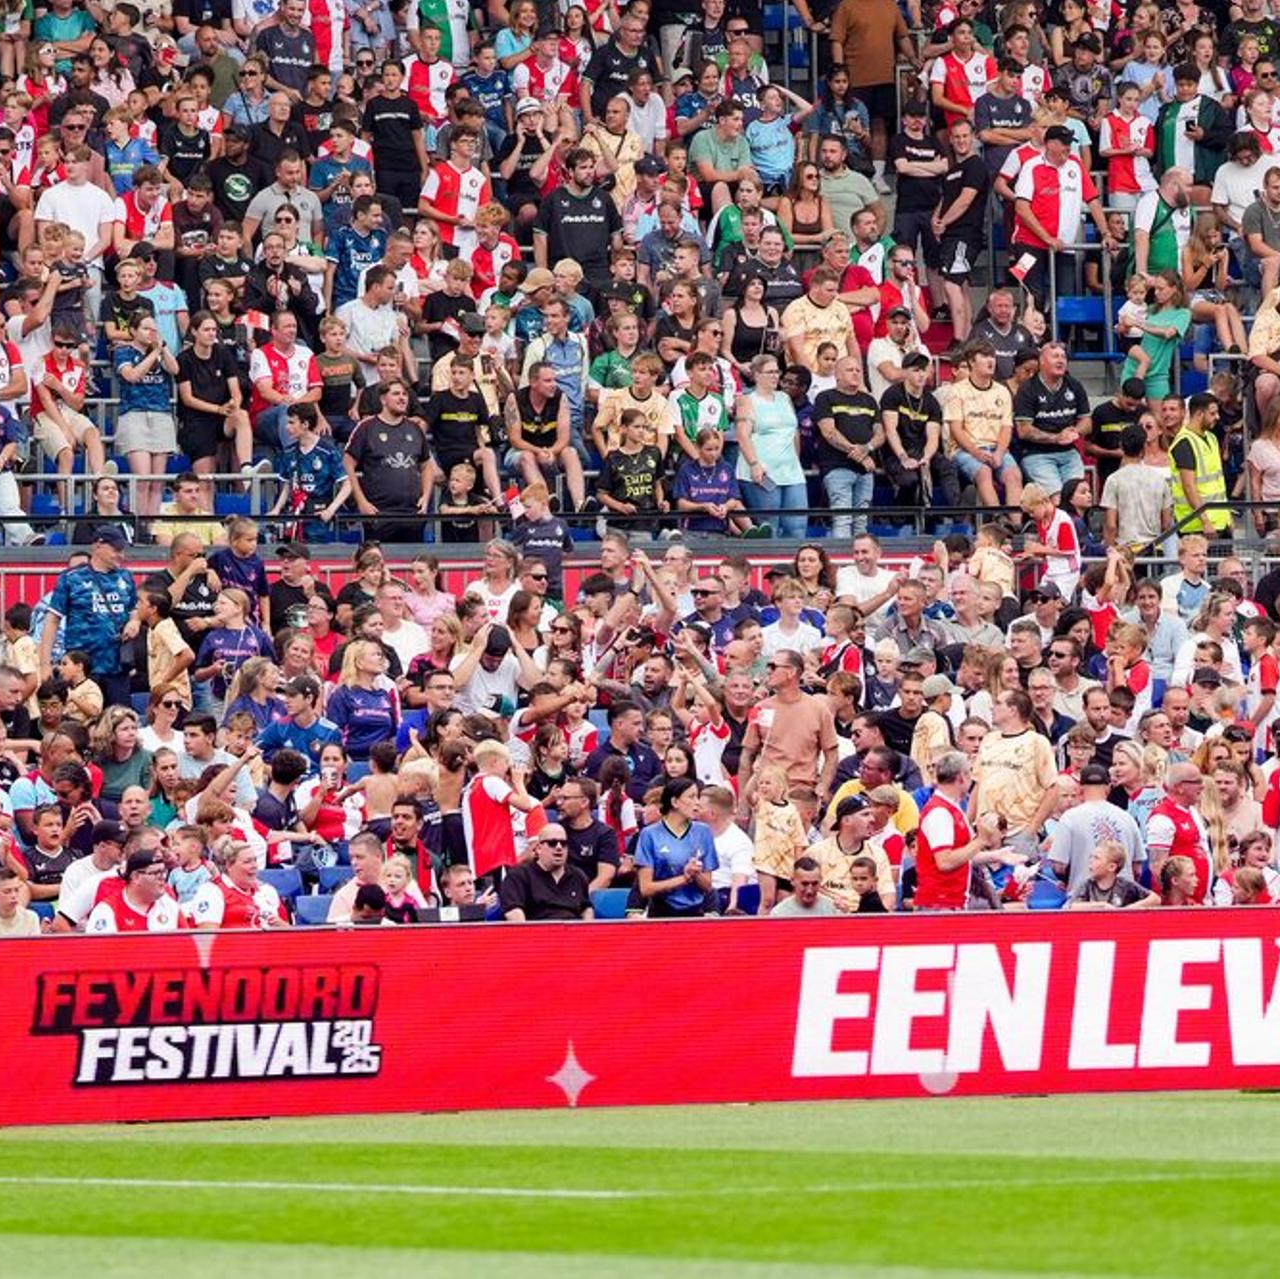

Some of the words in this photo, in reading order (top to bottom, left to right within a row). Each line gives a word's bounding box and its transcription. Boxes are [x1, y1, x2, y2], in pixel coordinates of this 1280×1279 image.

[35, 965, 379, 1027] FEYENOORD
[791, 942, 1052, 1078] EEN
[76, 1020, 337, 1083] FESTIVAL
